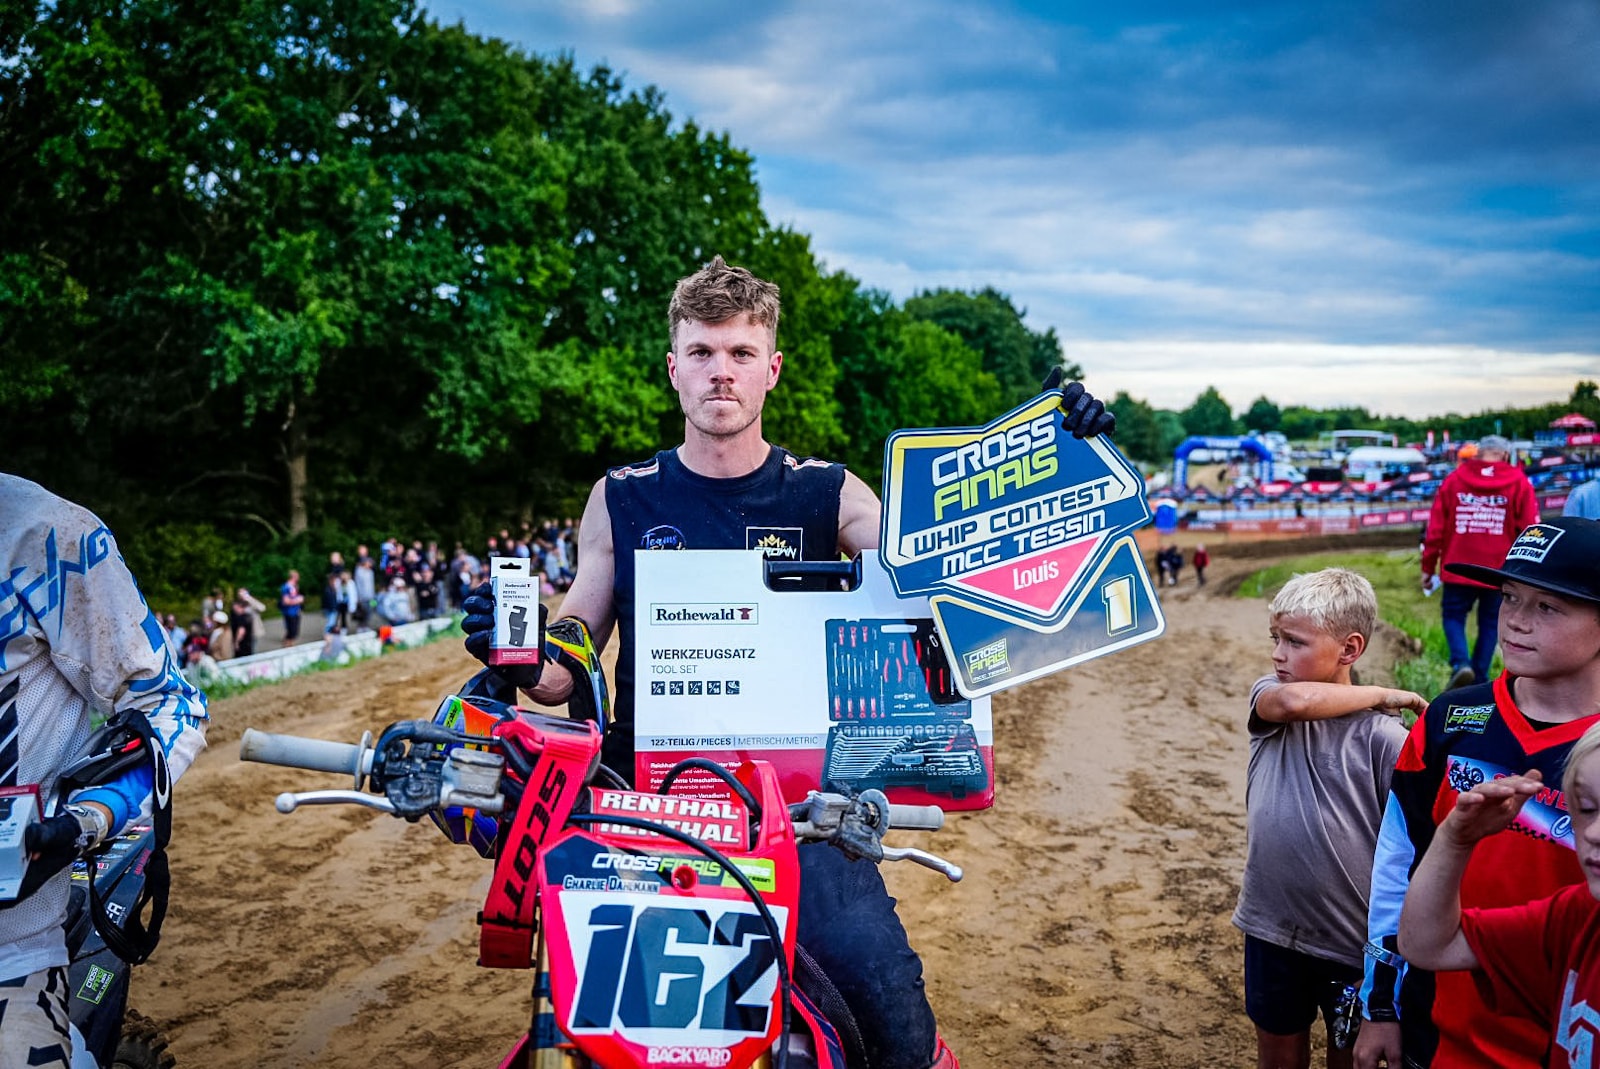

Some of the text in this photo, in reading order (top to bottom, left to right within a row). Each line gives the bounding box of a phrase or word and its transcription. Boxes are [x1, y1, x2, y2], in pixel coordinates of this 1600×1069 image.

[932, 414, 1056, 486] CROSS
[934, 445, 1058, 521] FINALS
[914, 481, 1110, 557] WHIP CONTEST
[942, 510, 1106, 577] MCC TESSIN
[1520, 549, 1544, 559] TEAM
[1013, 559, 1059, 590] Louis
[656, 608, 735, 621] Rothewald
[1103, 575, 1134, 634] 1
[651, 649, 756, 659] WERKZEUGSATZ
[969, 641, 1004, 664] CROSS
[651, 665, 698, 674] TOOL SET
[601, 793, 738, 819] RENTHAL
[572, 905, 778, 1033] 162
[647, 1047, 731, 1063] BACKYARD
